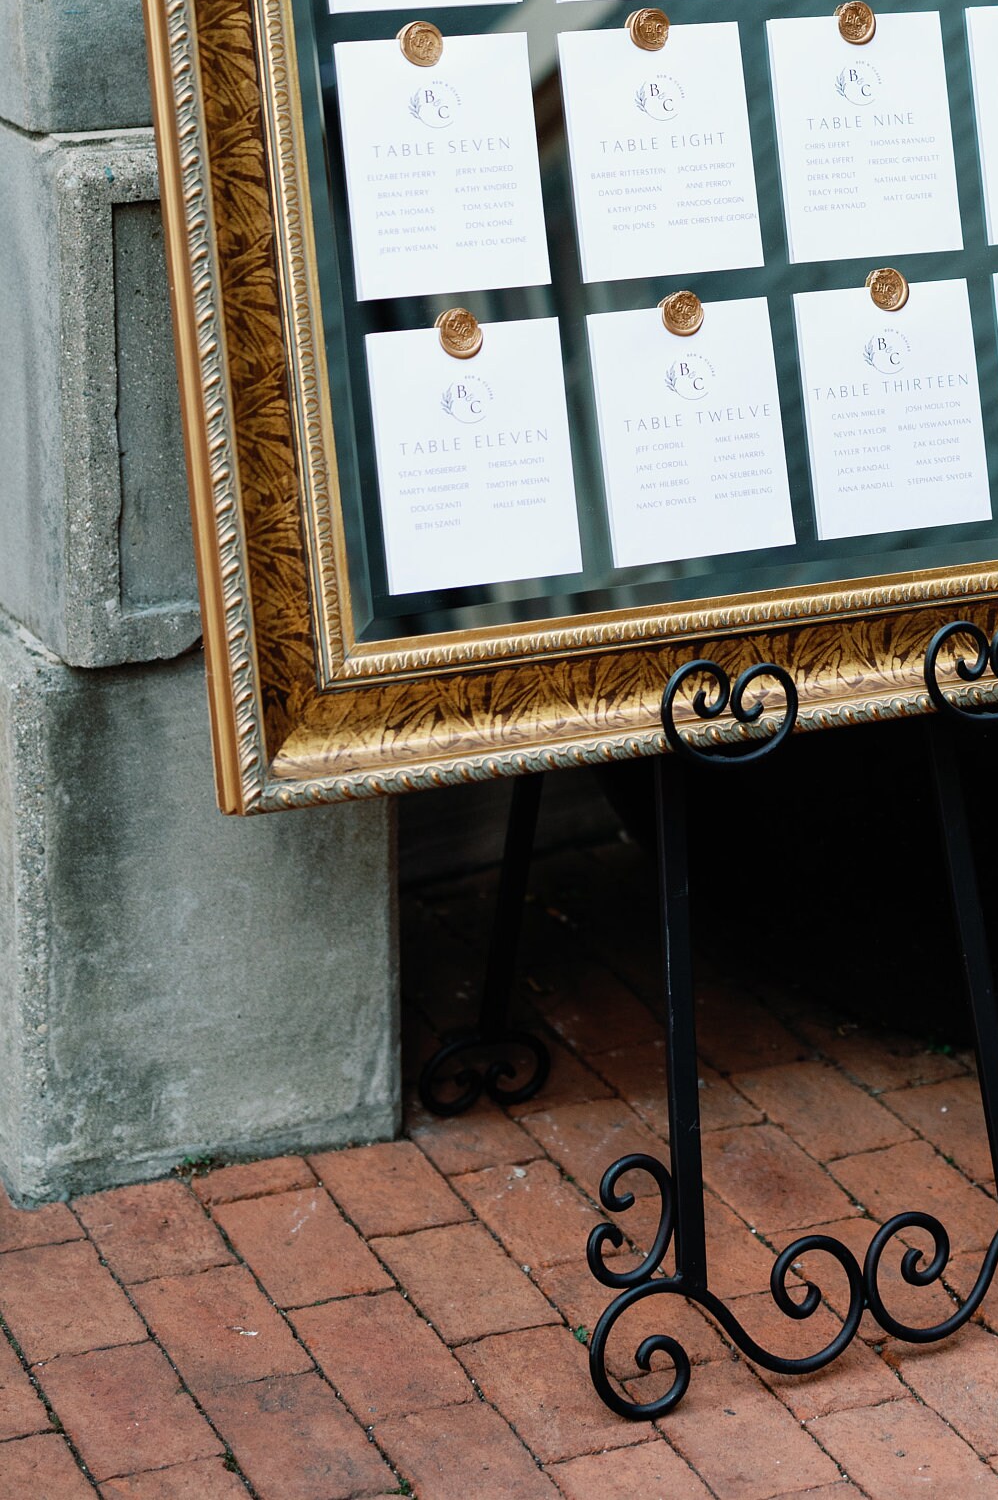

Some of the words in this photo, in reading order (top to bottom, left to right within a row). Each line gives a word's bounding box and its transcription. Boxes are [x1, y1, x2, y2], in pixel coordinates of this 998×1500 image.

[806, 115, 861, 131] TABLE
[873, 112, 913, 126] NINE
[372, 141, 434, 158] TABLE
[447, 136, 510, 153] SEVEN
[599, 136, 658, 153] TABLE
[670, 131, 724, 148] EIGHT
[806, 172, 830, 181] DEREK
[831, 171, 856, 180] PROUT
[376, 190, 403, 199] BRIAN
[404, 188, 429, 197] PERRY
[454, 184, 481, 194] KATHY
[482, 181, 519, 191] KINDRED
[598, 187, 624, 197] DAVID
[624, 184, 662, 194] BAHNMAN
[807, 188, 831, 197] TRACY
[831, 186, 858, 195] PROUT
[461, 202, 483, 211] TOM
[482, 200, 514, 210] SLAVEN
[607, 205, 632, 214] KATHY
[633, 203, 657, 212] JONES
[802, 204, 830, 213] CLAIRE
[830, 201, 867, 211] RAYNAUD
[465, 220, 485, 230] DON
[486, 218, 513, 228] KOHNE
[612, 223, 631, 231] RON
[631, 221, 655, 231] JONES
[813, 383, 869, 400] TABLE
[882, 373, 968, 393] THIRTEEN
[623, 413, 682, 432] TABLE
[695, 403, 770, 424] TWELVE
[832, 428, 858, 439] NEVIN
[857, 425, 887, 436] TAYLOR
[399, 436, 460, 456] TABLE
[474, 428, 548, 449] ELEVEN
[713, 452, 738, 462] LYNNE
[738, 449, 767, 460] HARRIS
[836, 466, 854, 475] JACK
[856, 462, 890, 473] RANDALL
[485, 478, 519, 489] TIMOTHY
[519, 475, 550, 486] MEEHAN
[639, 481, 658, 491] AMY
[658, 477, 689, 488] HILBERG
[906, 473, 945, 485] STEPHANIE
[944, 470, 974, 481] SNYDER
[409, 503, 434, 513] DOUG
[434, 500, 462, 510] SZANTI
[635, 499, 663, 510] NANCY
[663, 495, 696, 507] BOWLES
